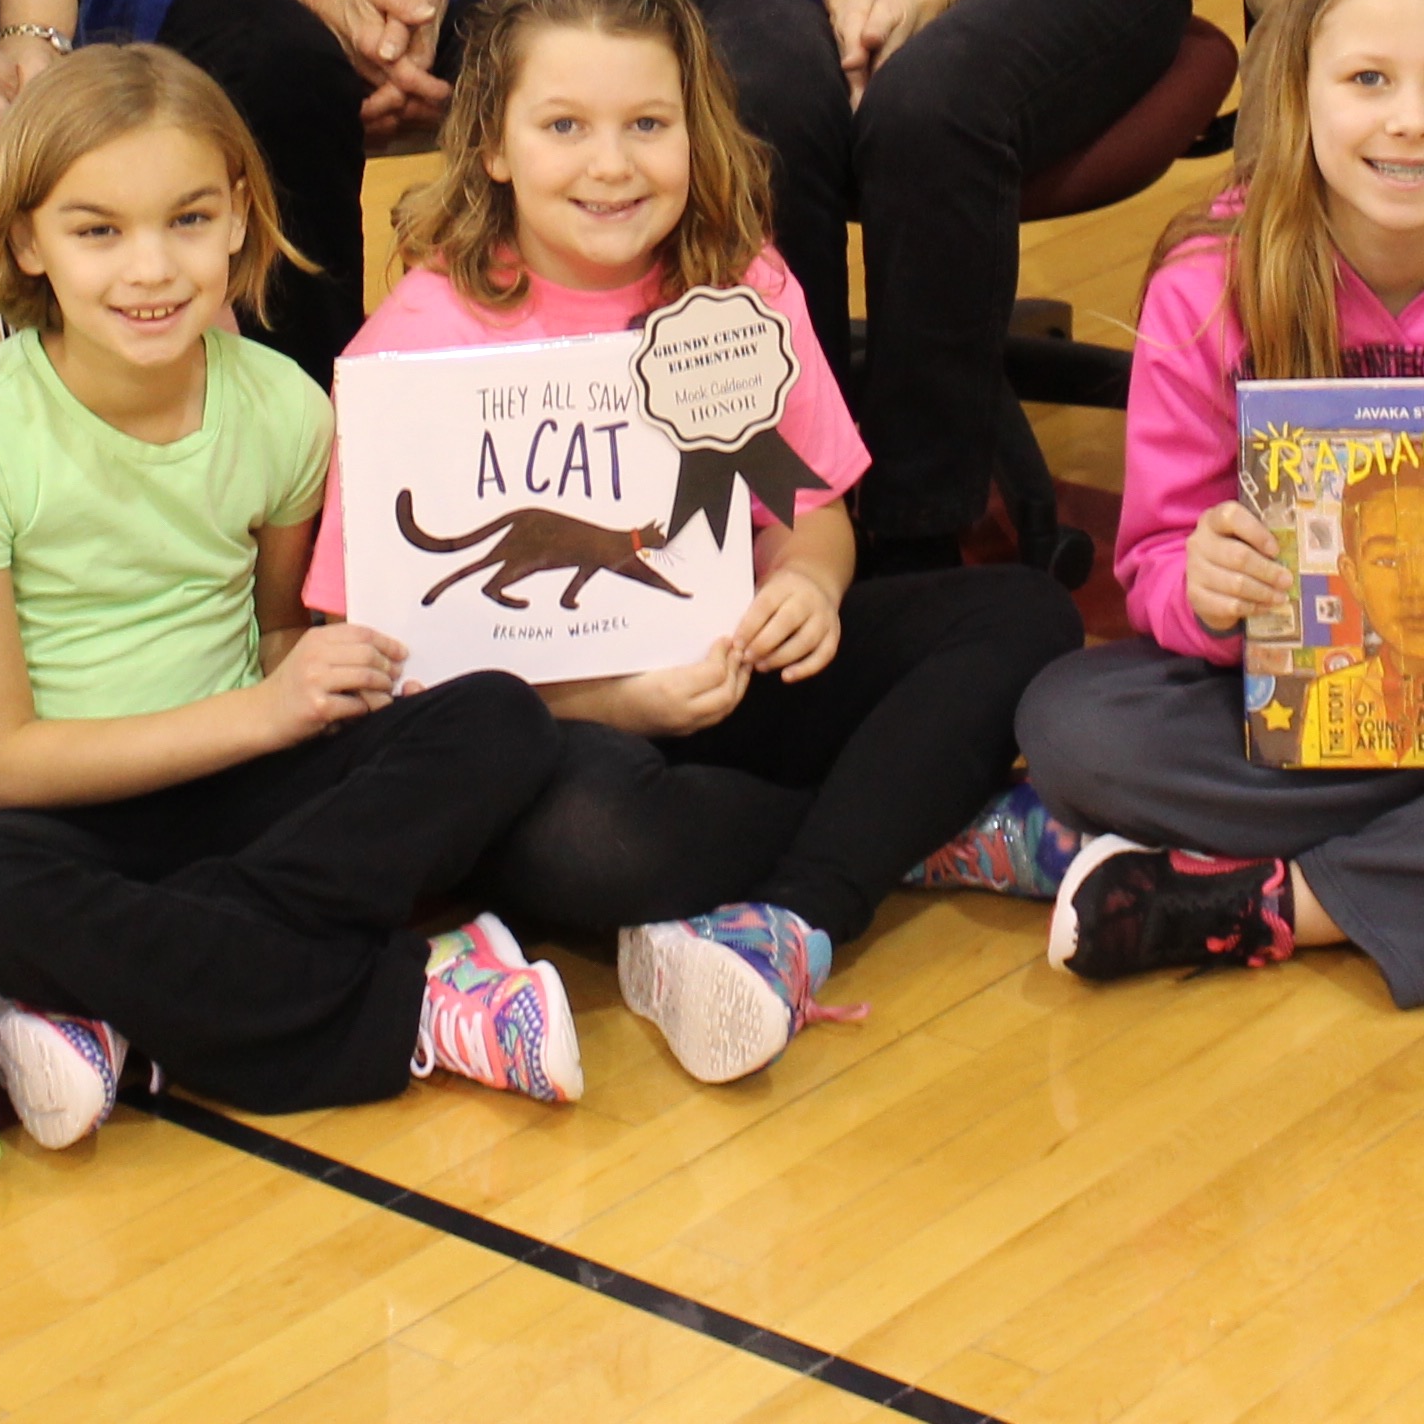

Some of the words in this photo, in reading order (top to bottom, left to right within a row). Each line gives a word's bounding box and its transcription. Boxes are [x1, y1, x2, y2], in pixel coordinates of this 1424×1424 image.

[653, 335, 710, 359] GRUNDY
[713, 322, 767, 345] CENTER
[668, 341, 759, 374] ELEMENTARY
[476, 385, 528, 421] THEY
[542, 380, 576, 411] ALL
[587, 381, 633, 413] SAW
[675, 385, 708, 405] Mock
[710, 373, 763, 397] Caldecott
[690, 395, 757, 423] HONOR
[1354, 407, 1409, 421] JAVAKA
[477, 429, 507, 499] A
[525, 418, 629, 501] CAT
[492, 623, 554, 641] BRENDAN
[567, 616, 630, 637] WENZEL
[1328, 681, 1345, 724] STORY
[1354, 700, 1376, 717] OF
[1328, 729, 1345, 752] THE
[1355, 719, 1406, 734] YOUNG
[1355, 734, 1407, 751] ARTIST
